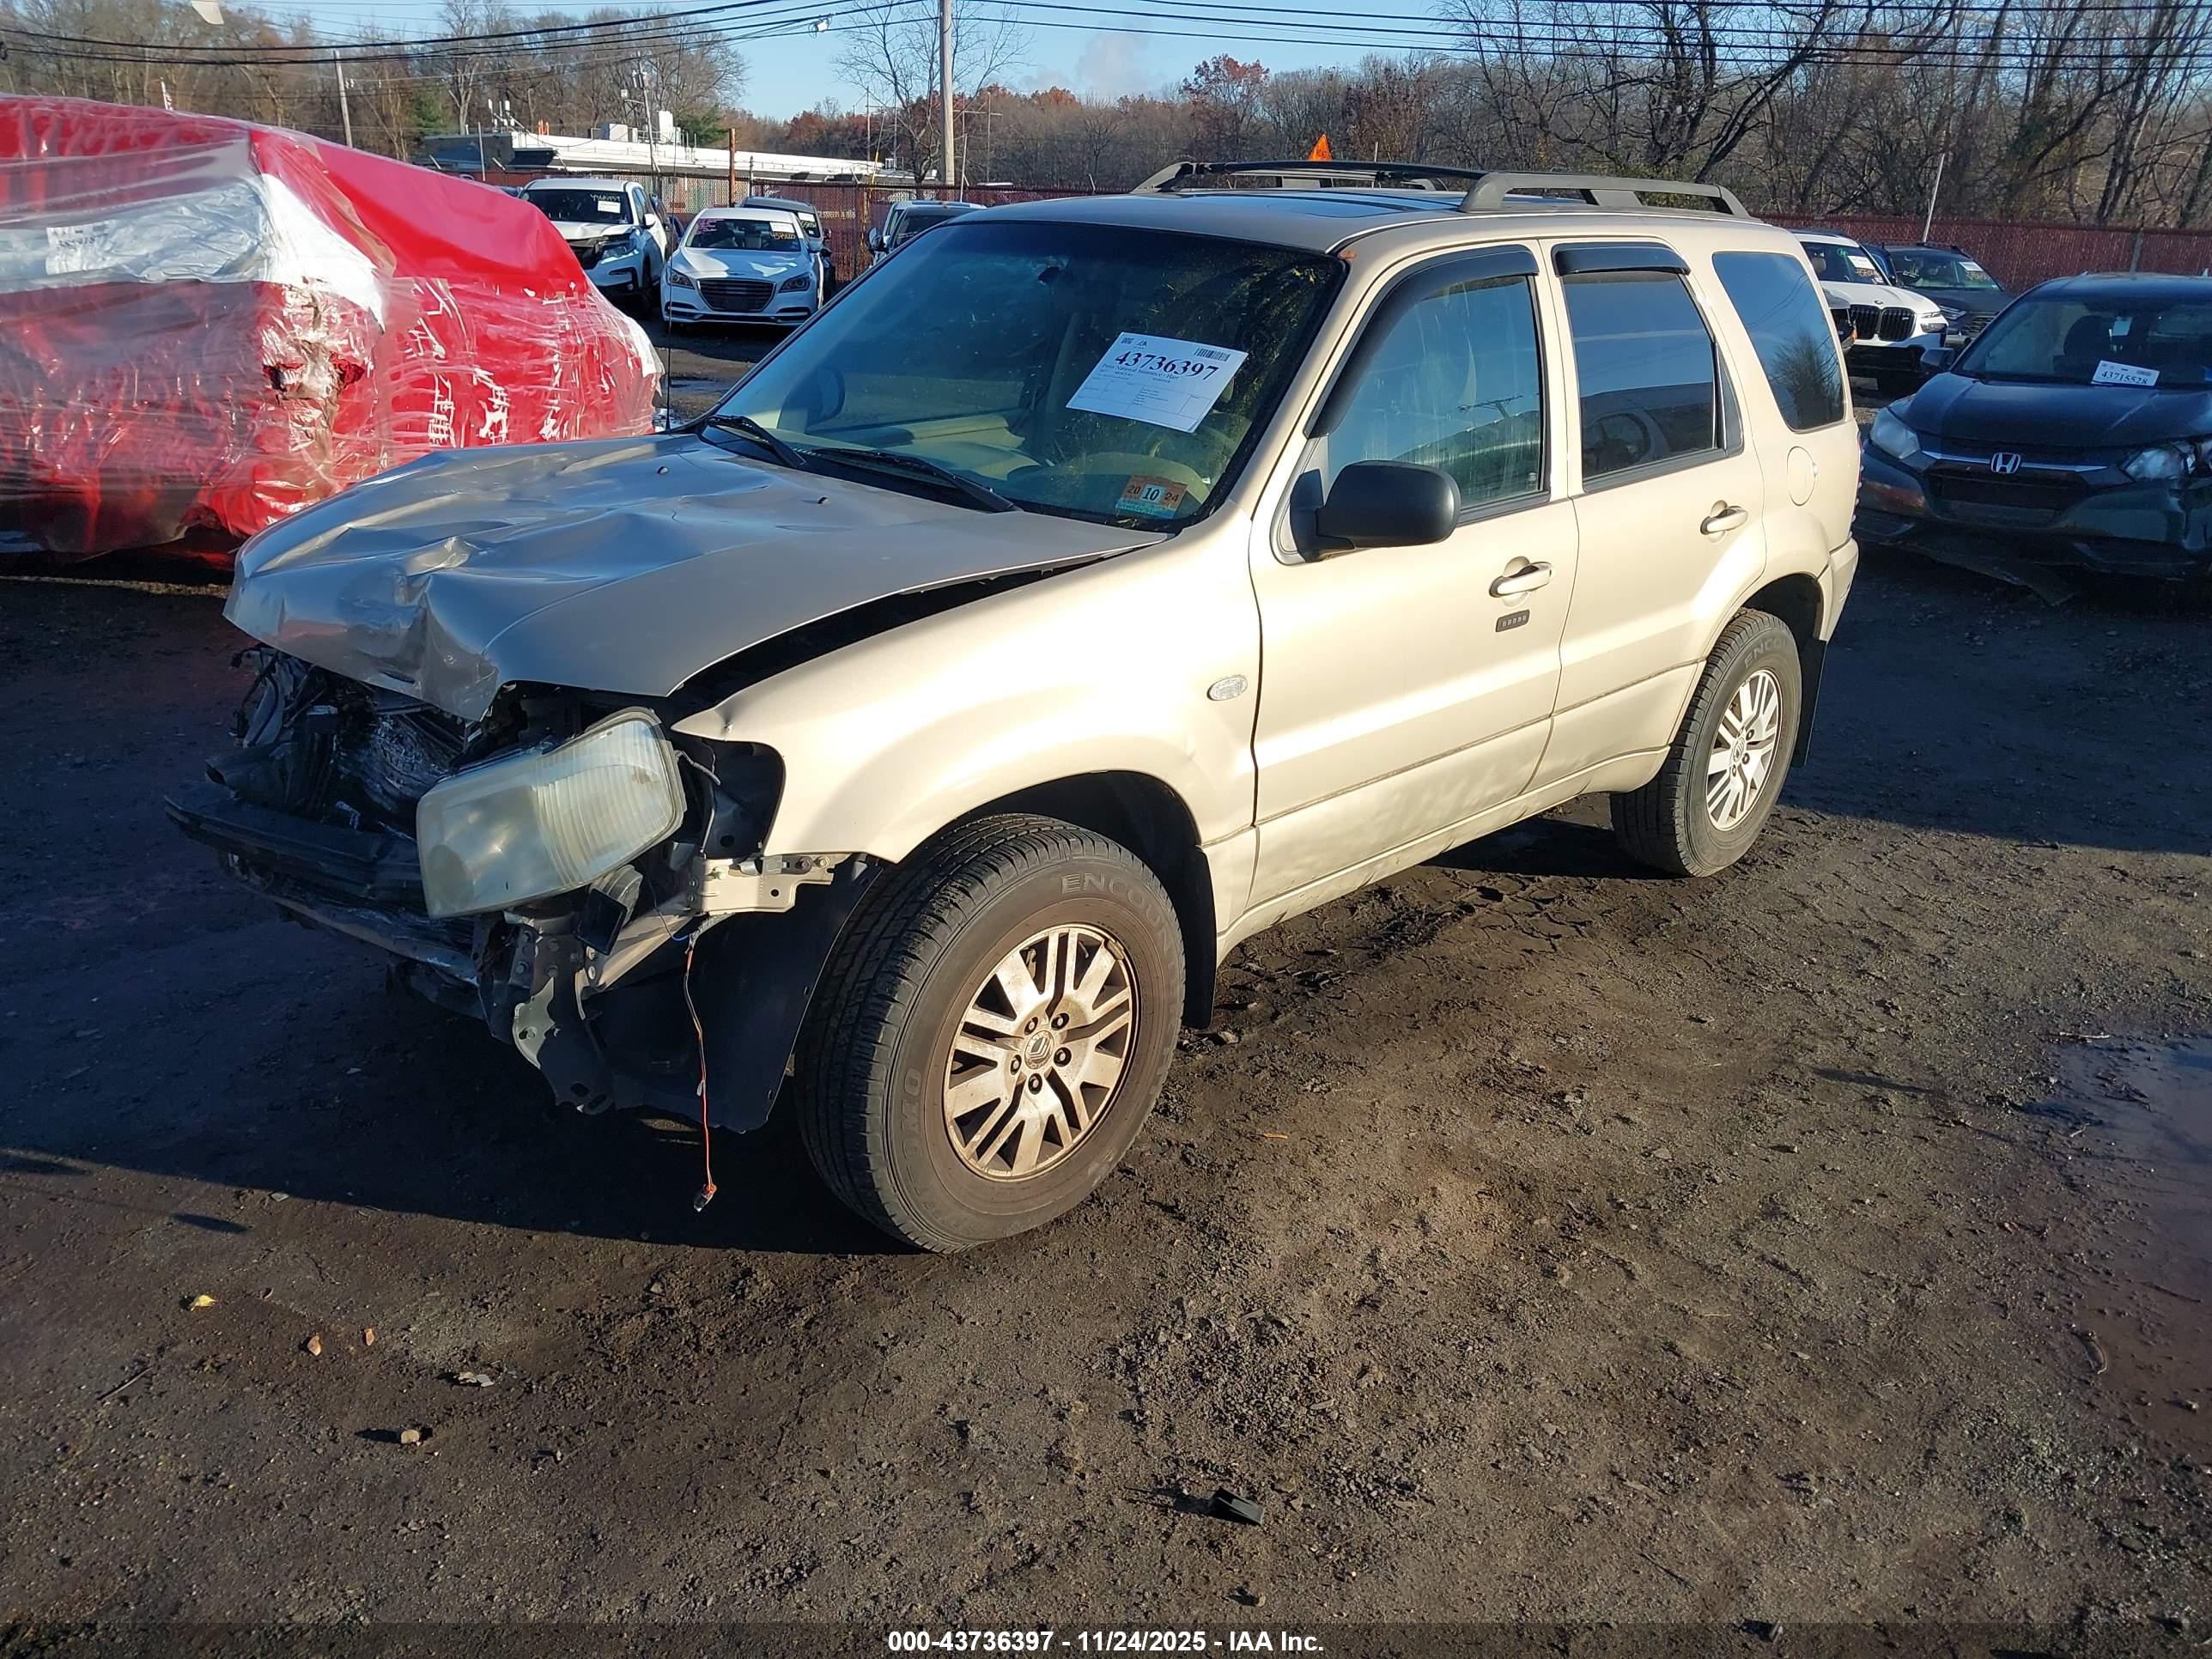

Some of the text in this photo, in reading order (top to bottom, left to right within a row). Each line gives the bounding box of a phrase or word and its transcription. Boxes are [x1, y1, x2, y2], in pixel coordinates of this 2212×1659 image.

[1115, 350, 1219, 380] 43736397
[2101, 370, 2148, 385] 43715528
[1127, 484, 1141, 495] 20
[1142, 486, 1160, 501] 10
